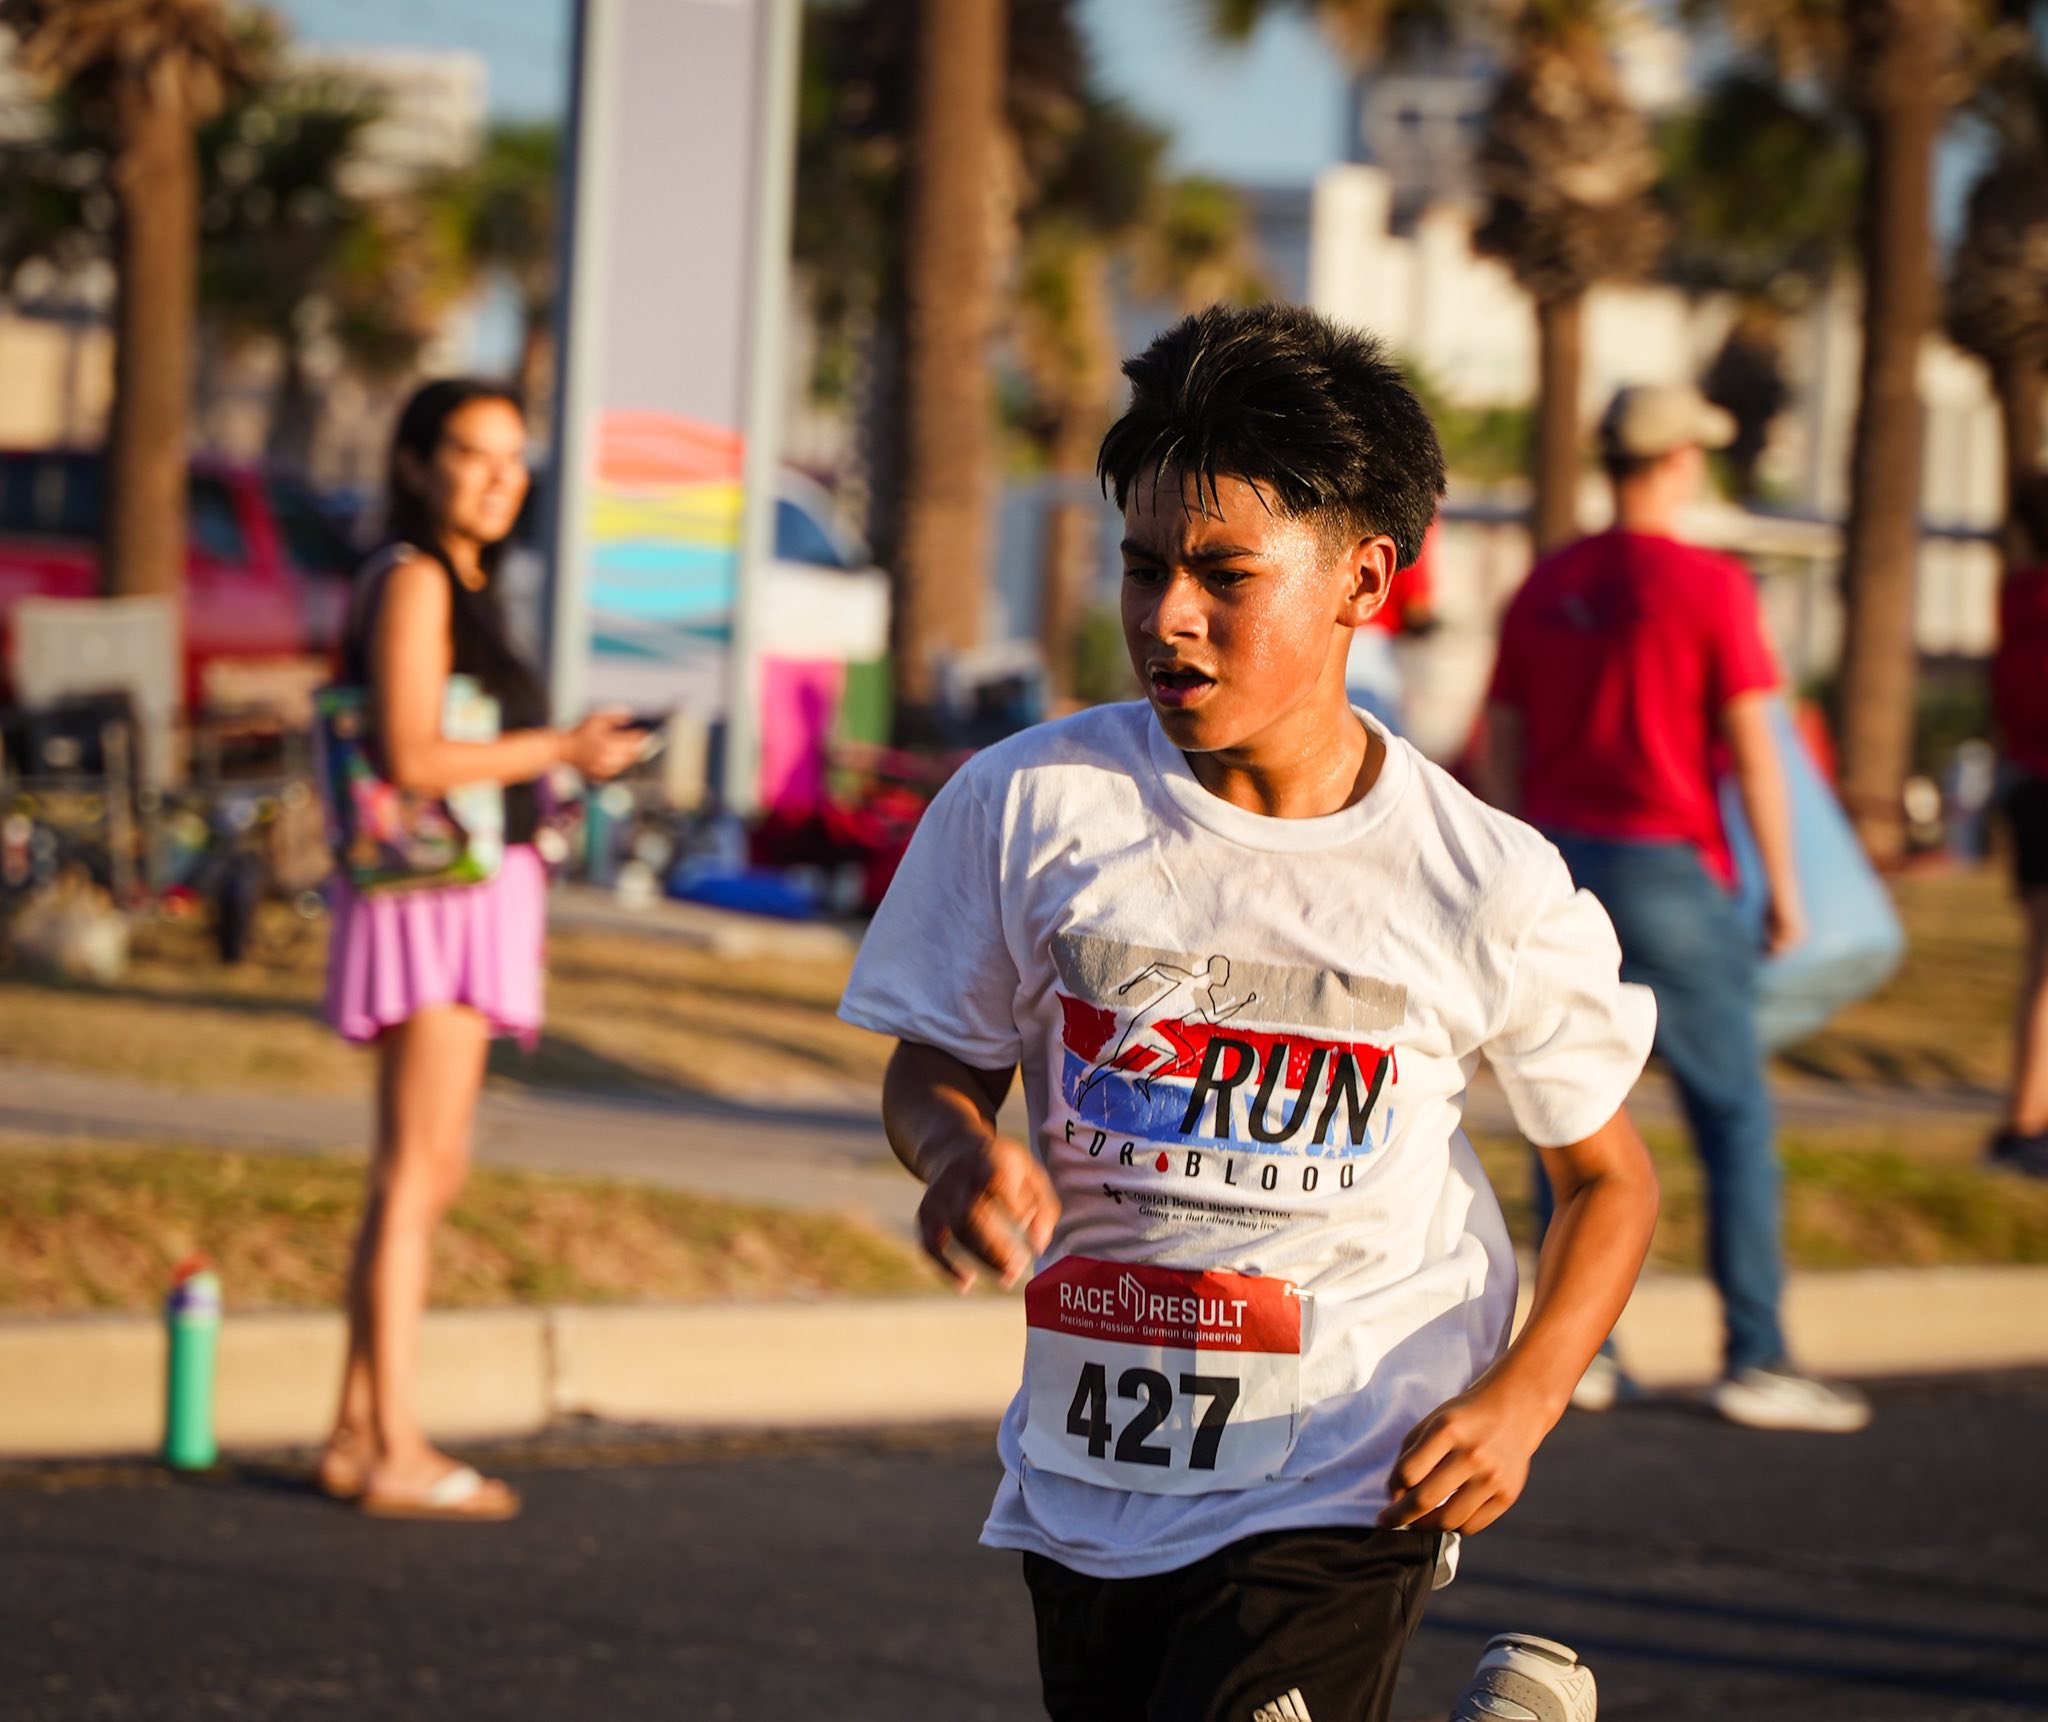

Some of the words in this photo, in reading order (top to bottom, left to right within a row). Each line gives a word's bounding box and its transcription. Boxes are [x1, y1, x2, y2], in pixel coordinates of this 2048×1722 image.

[1179, 1035, 1389, 1146] RUN
[1065, 1119, 1134, 1166] FOR
[1185, 1151, 1354, 1192] BLOOD
[1124, 1190, 1168, 1206] oastal
[1172, 1197, 1204, 1210] Bend
[1139, 1205, 1170, 1222] Giving
[1172, 1213, 1183, 1221] so
[1186, 1210, 1204, 1222] that
[1206, 1213, 1235, 1226] others
[1237, 1220, 1258, 1231] may
[1060, 1282, 1115, 1317] RACE
[1150, 1294, 1248, 1328] RESULT
[1060, 1313, 1094, 1329] Precision
[1100, 1321, 1135, 1334] Passion
[1142, 1326, 1180, 1339] German
[1182, 1329, 1242, 1345] Engineering
[1066, 1361, 1240, 1471] 427
